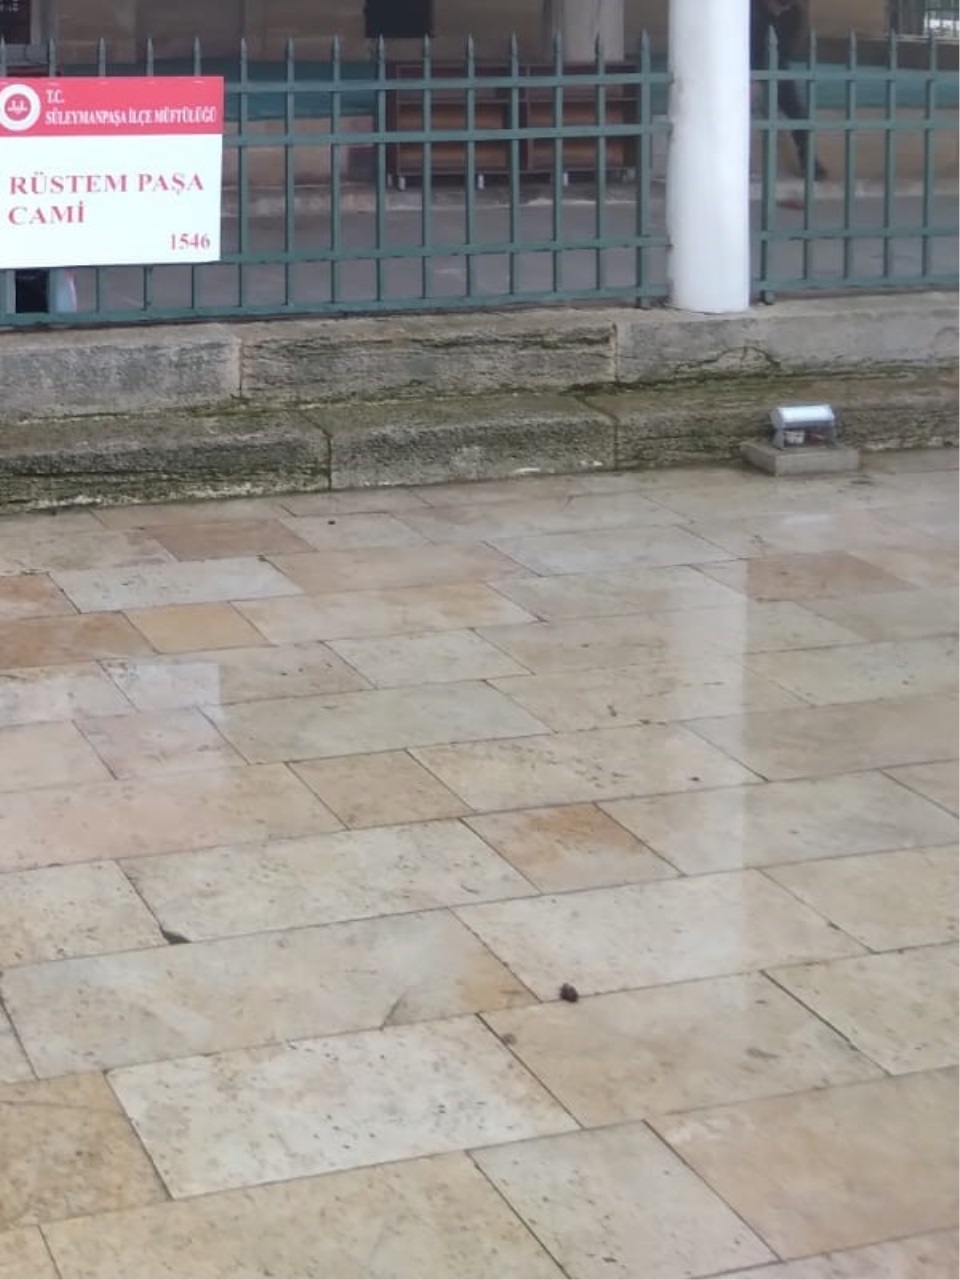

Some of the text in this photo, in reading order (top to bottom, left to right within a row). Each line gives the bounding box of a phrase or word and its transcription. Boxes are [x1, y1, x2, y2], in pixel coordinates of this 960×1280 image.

[45, 106, 217, 126] SÜLEYMANPAŞA İLÇE MÜFTÜLÜĞÜ
[9, 171, 204, 195] RÜSTEM PAŞA
[8, 200, 85, 225] CAMİ
[170, 233, 211, 250] 1546
